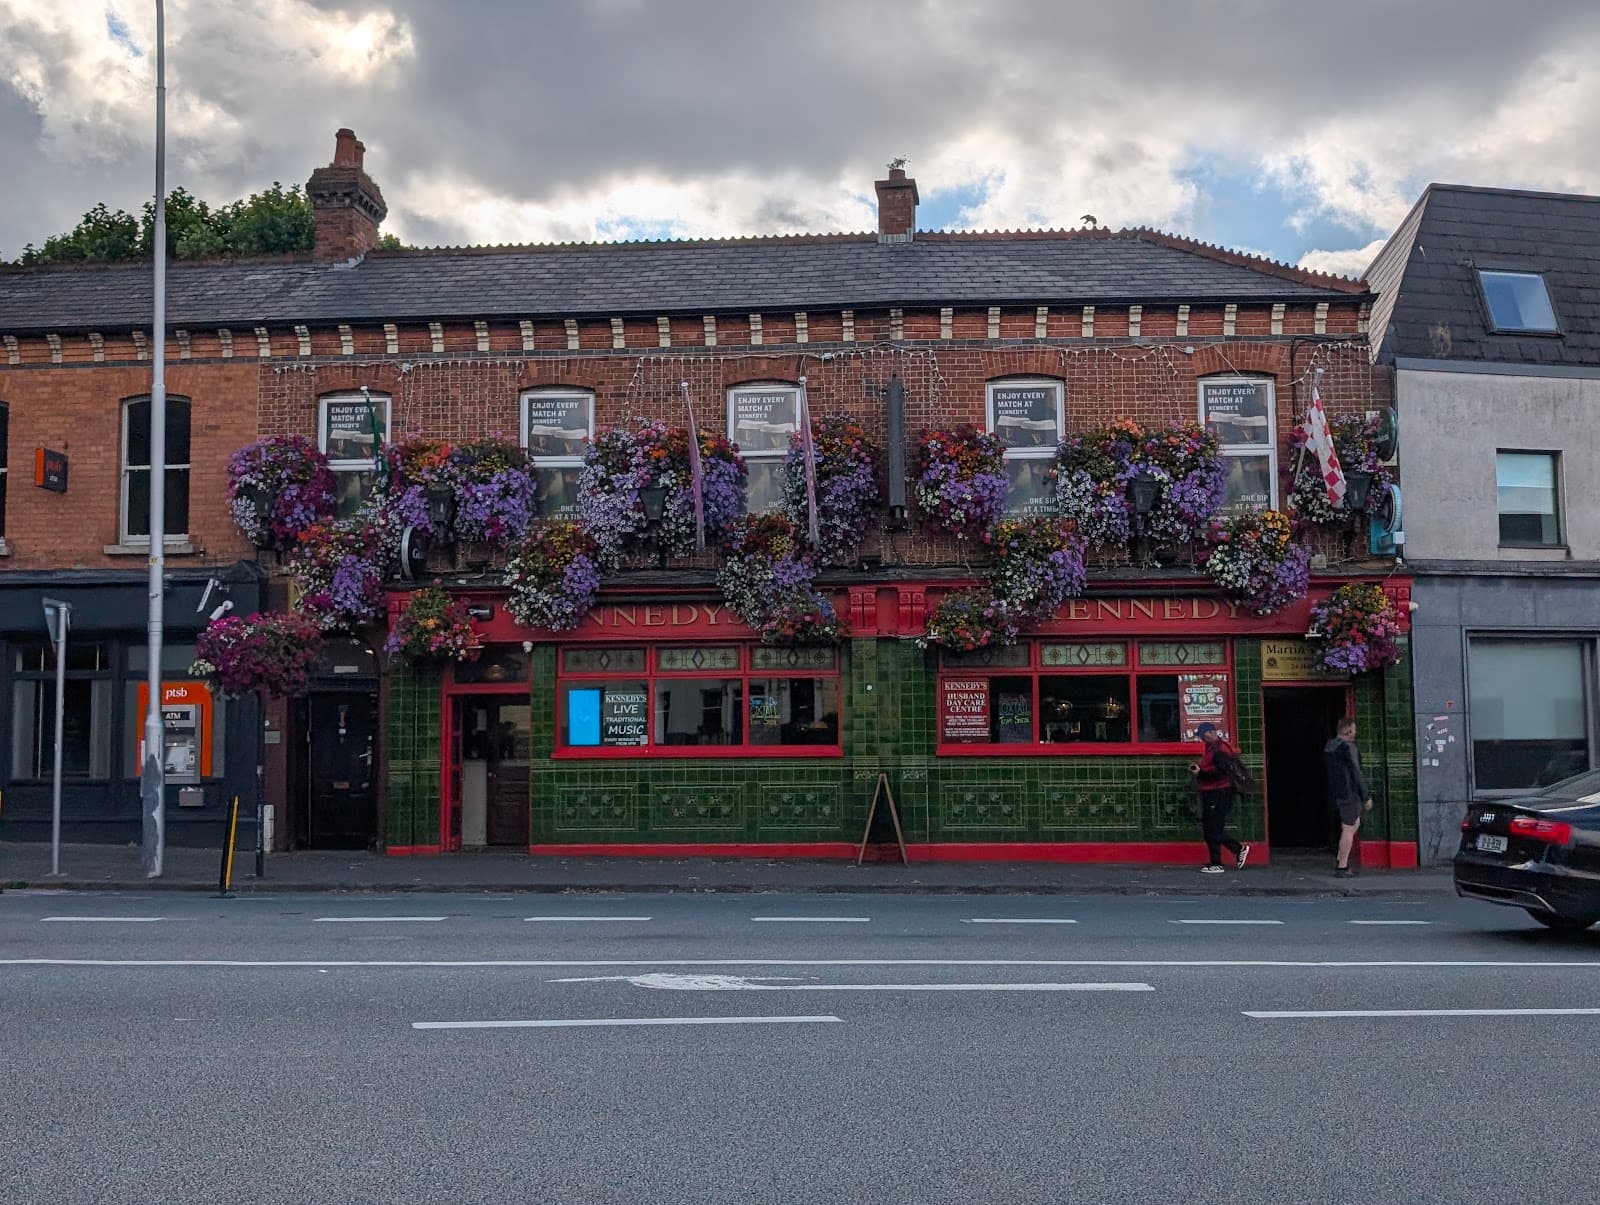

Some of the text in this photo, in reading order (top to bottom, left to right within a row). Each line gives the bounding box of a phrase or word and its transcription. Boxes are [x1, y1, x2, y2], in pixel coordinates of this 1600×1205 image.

[997, 391, 1046, 400] ENJOY EVERY
[1207, 387, 1256, 396] ENJOY EVERY
[997, 400, 1033, 408] MATCH AT
[1235, 396, 1244, 404] AT
[556, 401, 579, 409] EVERY
[764, 404, 774, 412] AT
[331, 406, 353, 414] ENJOY
[331, 414, 365, 422] MATCH AT
[1044, 497, 1057, 505] SIP
[1023, 505, 1033, 513] AT
[1234, 503, 1244, 511] AT
[555, 513, 564, 521] AT
[944, 682, 988, 690] KENNEDY'S
[165, 687, 188, 700] ptsb
[947, 692, 986, 700] HUSBAND
[605, 694, 647, 703] KENNEDY'S
[946, 699, 986, 707] DAY CARE
[613, 704, 639, 714] LIVE
[165, 712, 181, 720] ATM
[608, 725, 644, 735] MUSIC
